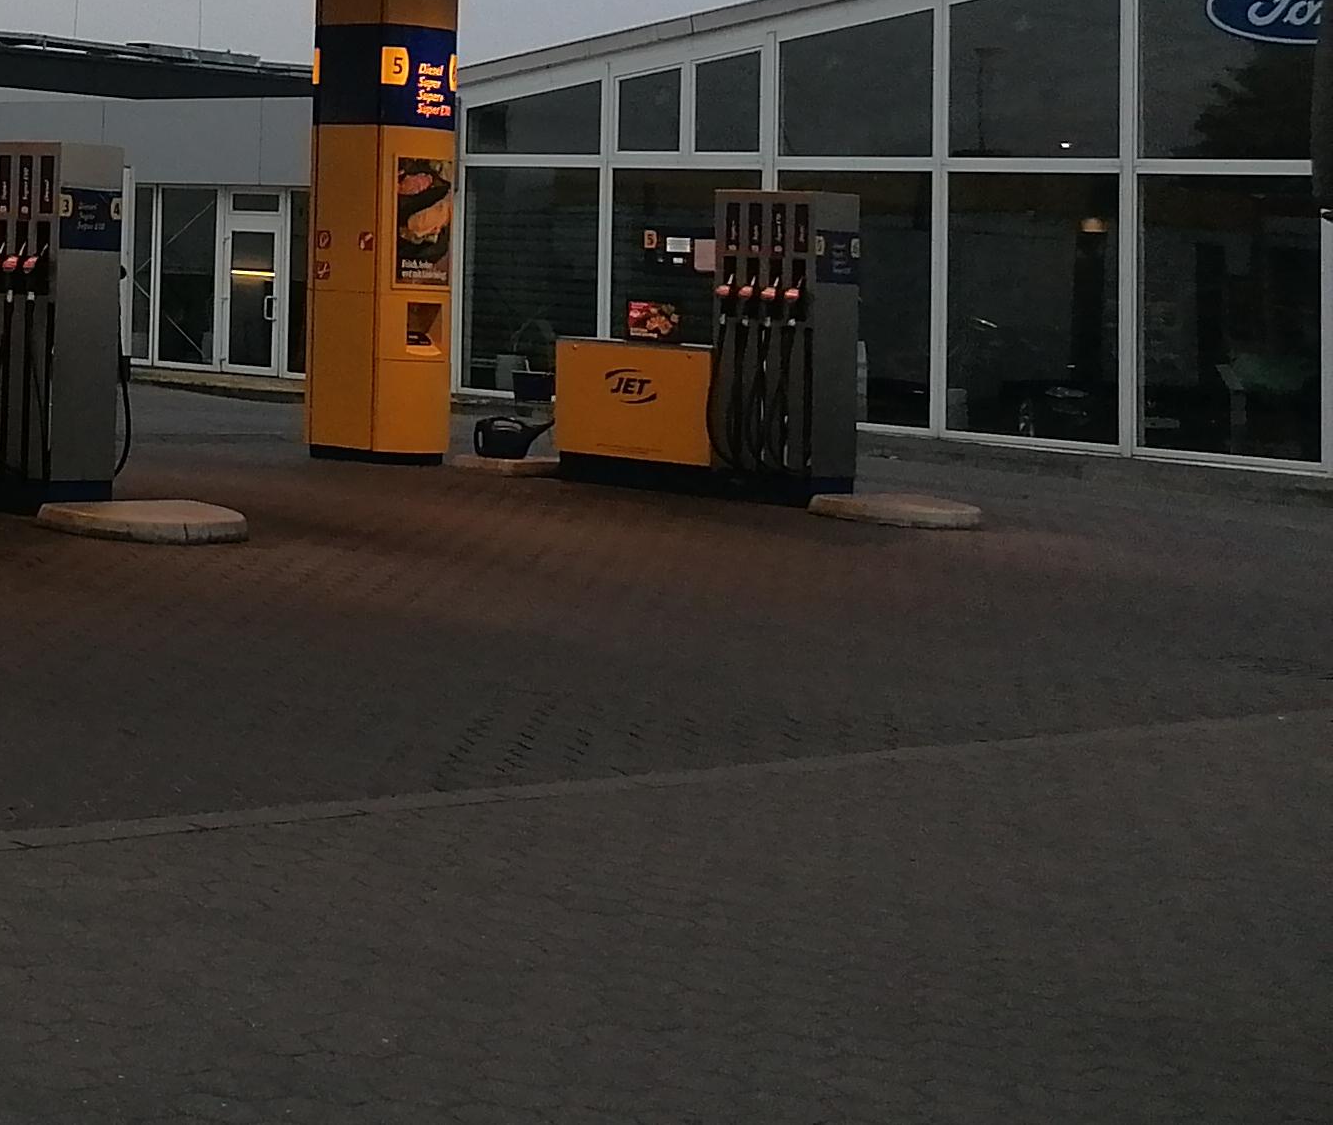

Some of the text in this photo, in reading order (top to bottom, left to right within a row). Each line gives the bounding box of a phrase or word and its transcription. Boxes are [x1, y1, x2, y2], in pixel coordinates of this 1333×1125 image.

[393, 57, 403, 75] 5
[418, 62, 445, 76] Diesel
[417, 76, 442, 91] Super
[416, 102, 441, 119] Super
[62, 198, 70, 214] 3
[610, 377, 652, 395] JET
